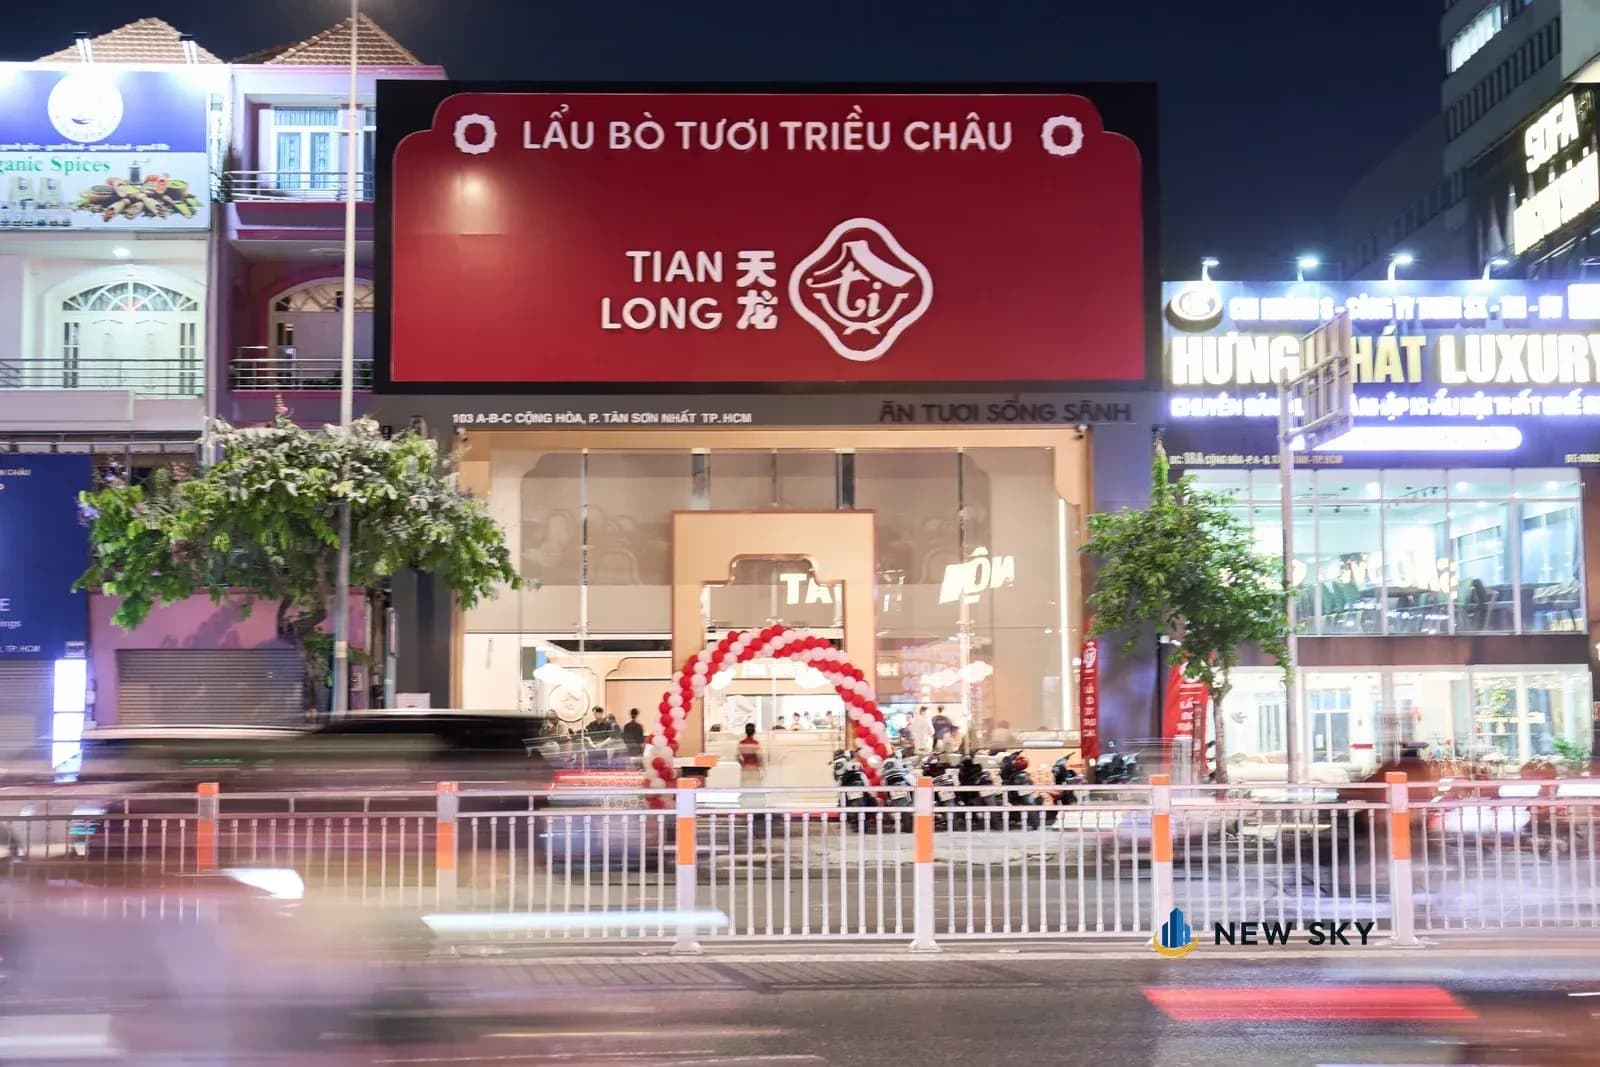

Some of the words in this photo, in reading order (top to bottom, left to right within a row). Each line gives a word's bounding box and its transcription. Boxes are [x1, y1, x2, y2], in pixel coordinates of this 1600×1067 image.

[523, 103, 594, 151] LẨU
[609, 111, 665, 151] BÒ
[675, 117, 769, 151] TƯƠI
[779, 104, 891, 152] TRIỀU
[904, 111, 1012, 152] CHÂU
[1525, 94, 1579, 173] SOFA
[50, 155, 111, 175] Spices
[625, 250, 724, 284] TIAN
[601, 296, 722, 331] LONG
[1172, 330, 1301, 385] HƯNG
[1347, 326, 1427, 385] HÁT
[452, 412, 474, 424] 103
[475, 412, 513, 424] A-B-C
[514, 410, 553, 425] CỘNG
[554, 410, 587, 425] HÒA,
[588, 412, 600, 424] P.
[602, 410, 629, 424] TÂN
[631, 411, 659, 424] SƠN
[661, 409, 696, 424] NHẤT
[879, 400, 915, 422] ĂN
